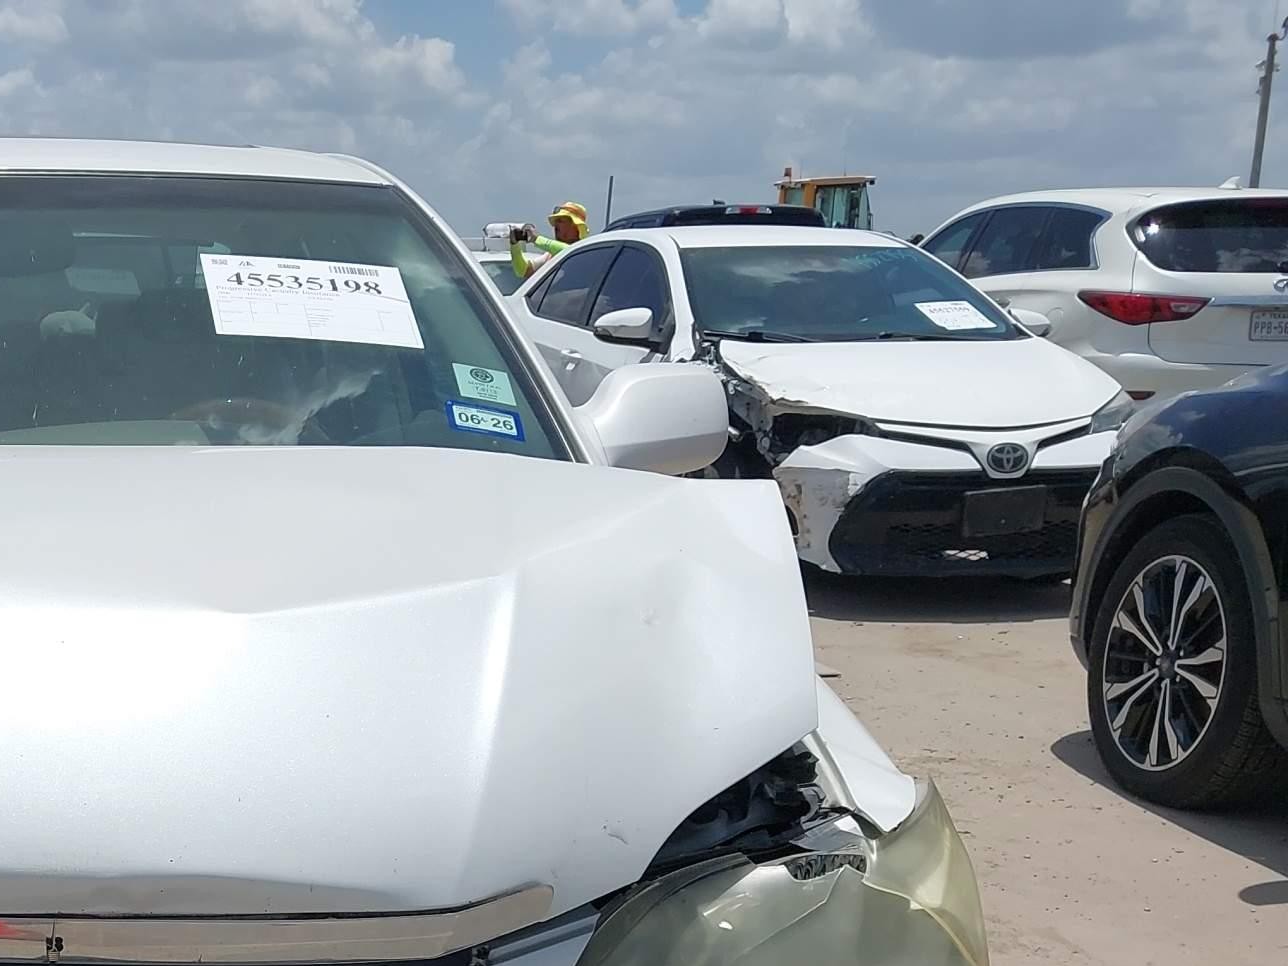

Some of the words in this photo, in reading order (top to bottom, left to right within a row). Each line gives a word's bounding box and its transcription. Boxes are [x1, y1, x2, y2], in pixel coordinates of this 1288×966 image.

[226, 272, 383, 295] 45535198
[458, 412, 481, 425] 06
[490, 417, 514, 431] 26
